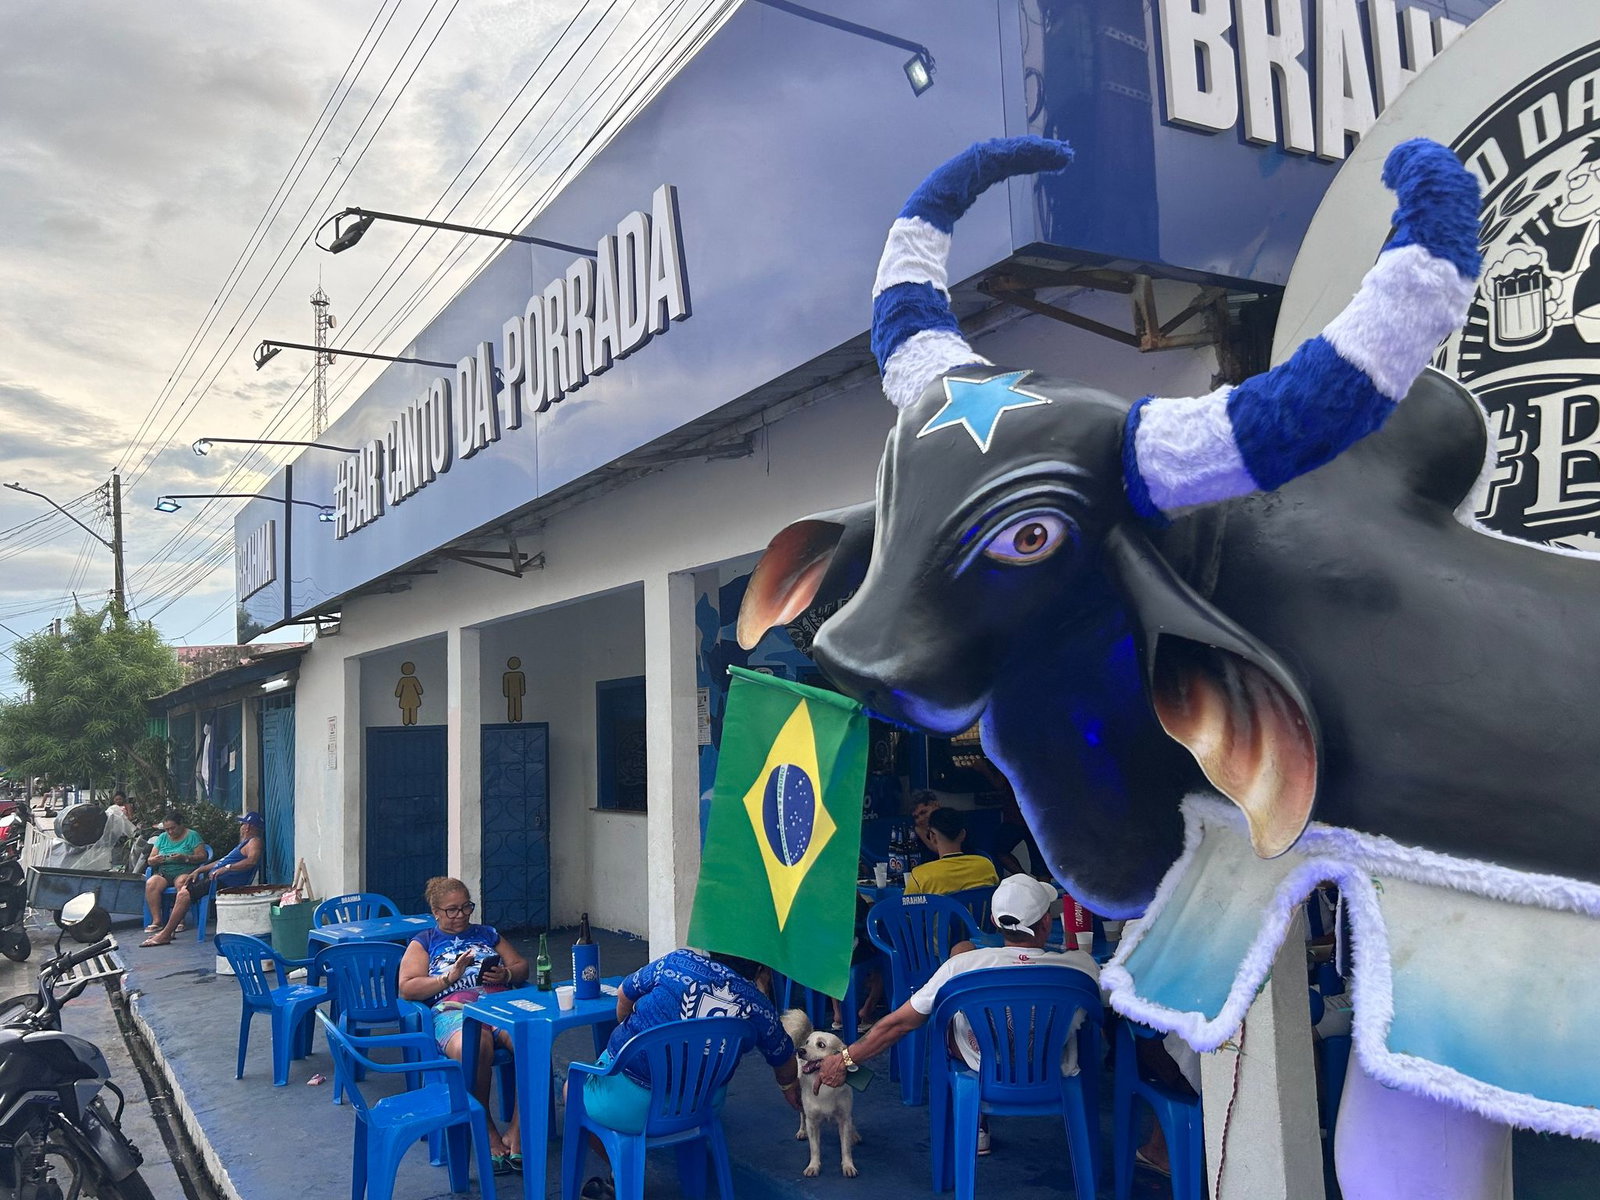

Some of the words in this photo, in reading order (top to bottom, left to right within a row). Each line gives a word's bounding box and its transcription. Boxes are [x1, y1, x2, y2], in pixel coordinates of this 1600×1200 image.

[1518, 67, 1600, 160] DA
[334, 440, 384, 540] #BAR
[384, 377, 452, 506] CANTO
[456, 341, 499, 460] DA
[502, 183, 690, 430] PORRADA
